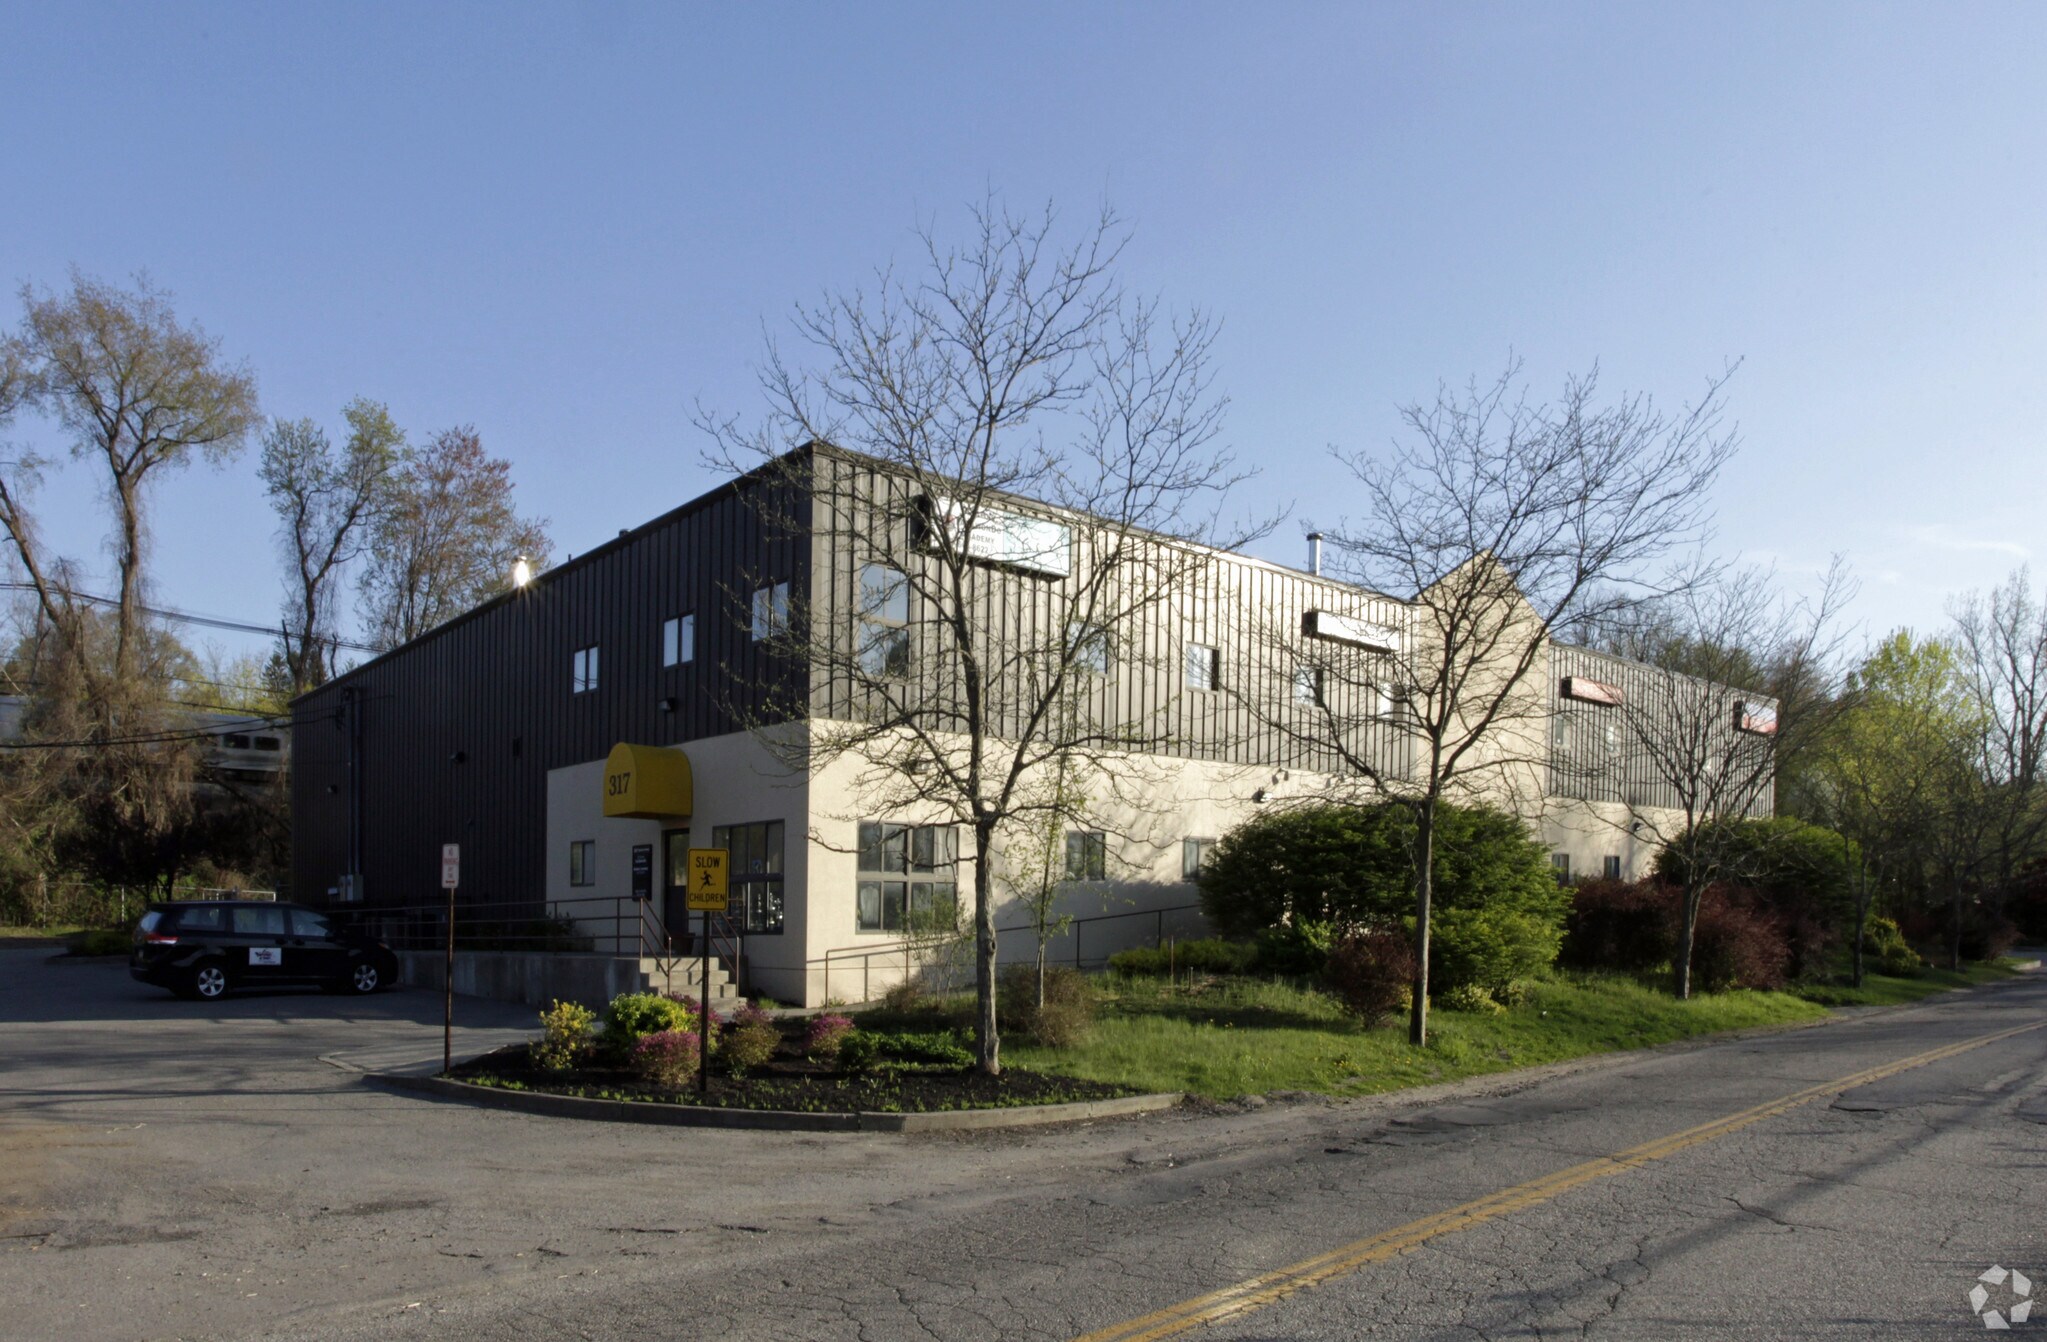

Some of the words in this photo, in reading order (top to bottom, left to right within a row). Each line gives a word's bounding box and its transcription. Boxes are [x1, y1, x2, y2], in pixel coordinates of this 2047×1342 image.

[971, 533, 995, 544] ADEMY
[609, 772, 630, 796] 317
[695, 856, 720, 868] SLOW
[689, 892, 725, 903] CHILDREN
